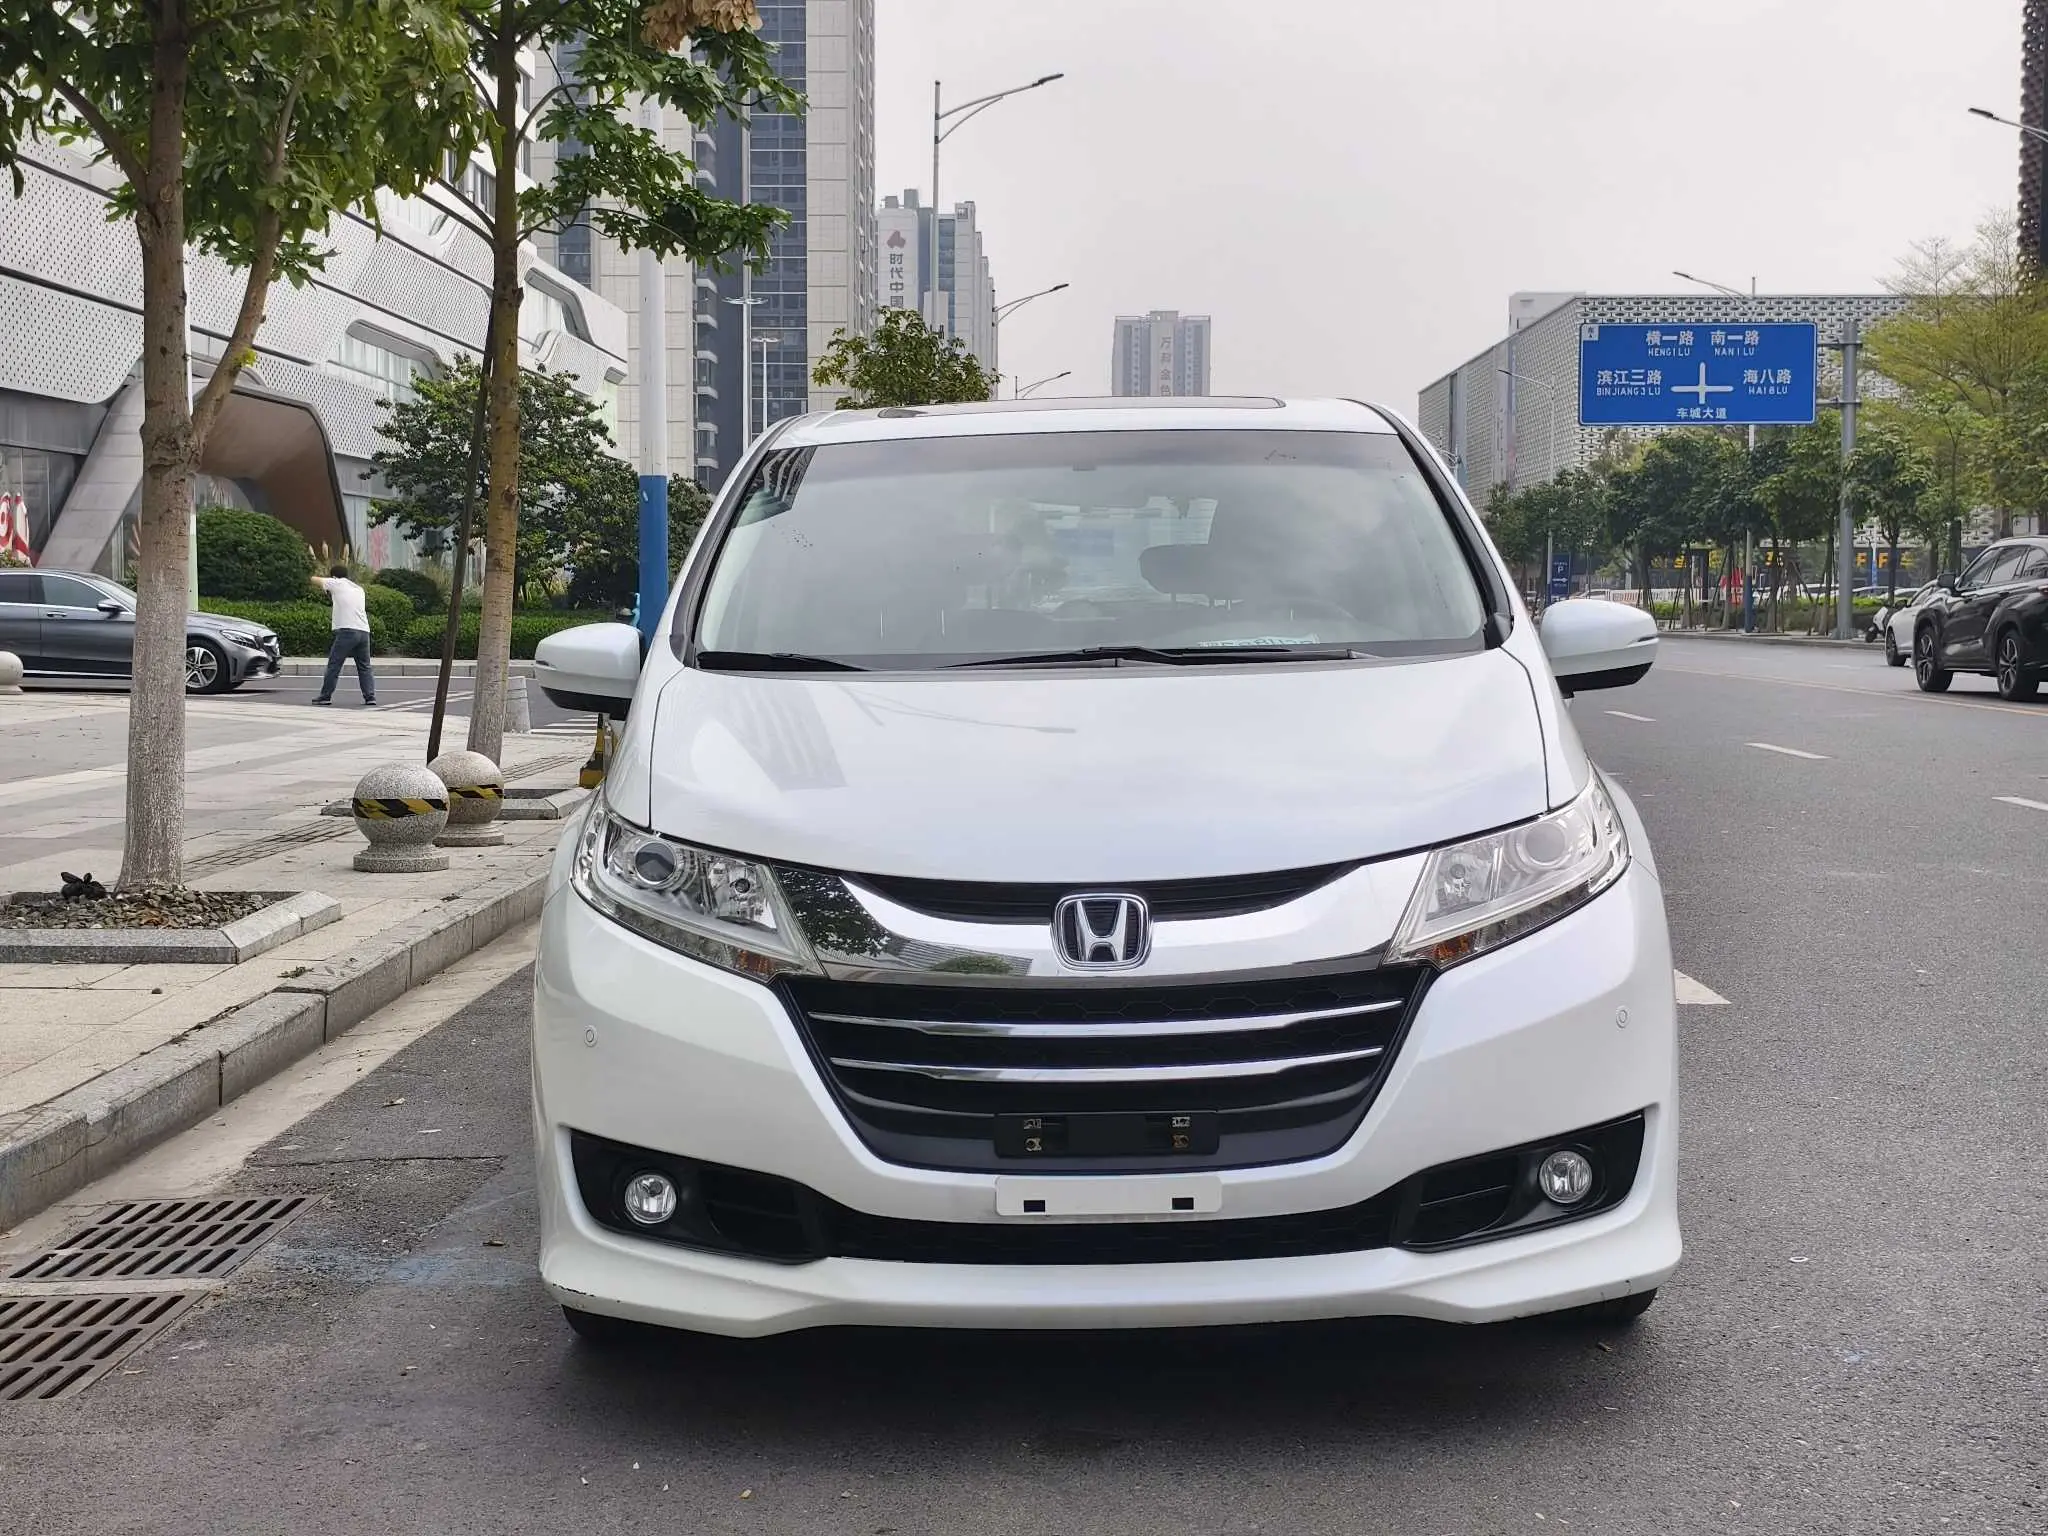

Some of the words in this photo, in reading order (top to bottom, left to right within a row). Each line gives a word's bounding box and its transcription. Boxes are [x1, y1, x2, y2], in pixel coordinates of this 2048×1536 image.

[1646, 330, 1694, 345] 横一路
[1711, 330, 1759, 345] 南一路
[1597, 369, 1661, 385] 滨江三路
[1743, 369, 1791, 384] 海八路
[1677, 407, 1727, 419] 车城大道
